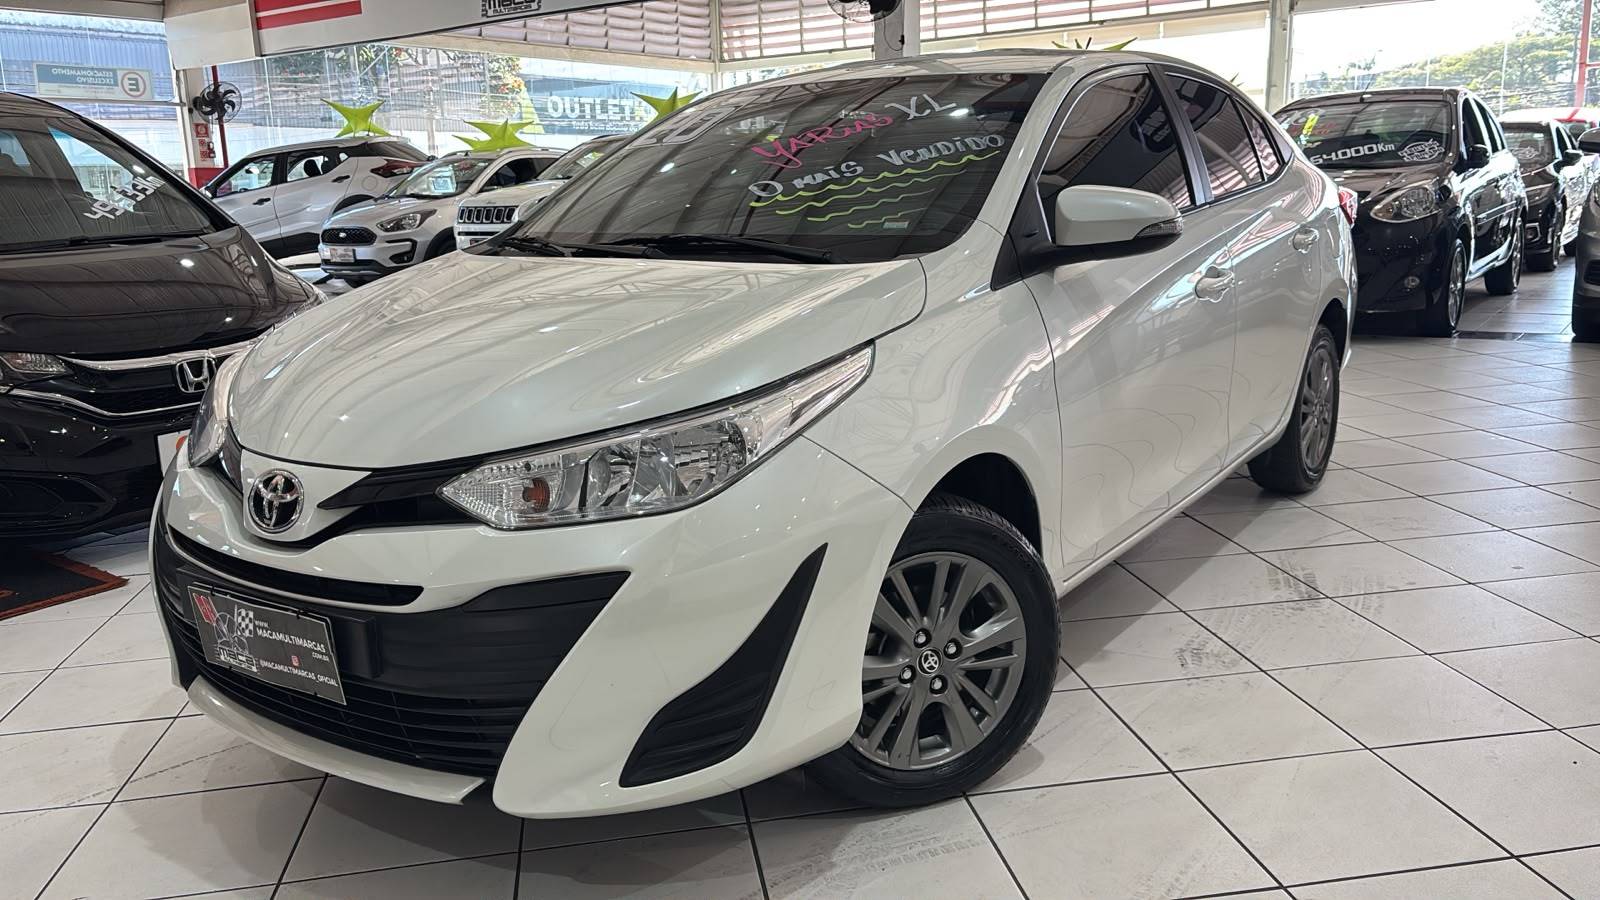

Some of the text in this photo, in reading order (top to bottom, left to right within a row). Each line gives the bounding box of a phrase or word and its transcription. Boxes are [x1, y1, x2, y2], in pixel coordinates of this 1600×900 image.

[547, 95, 632, 120] OUTLET
[884, 93, 957, 121] XL
[256, 628, 326, 653] MACAMULTIMARCAS
